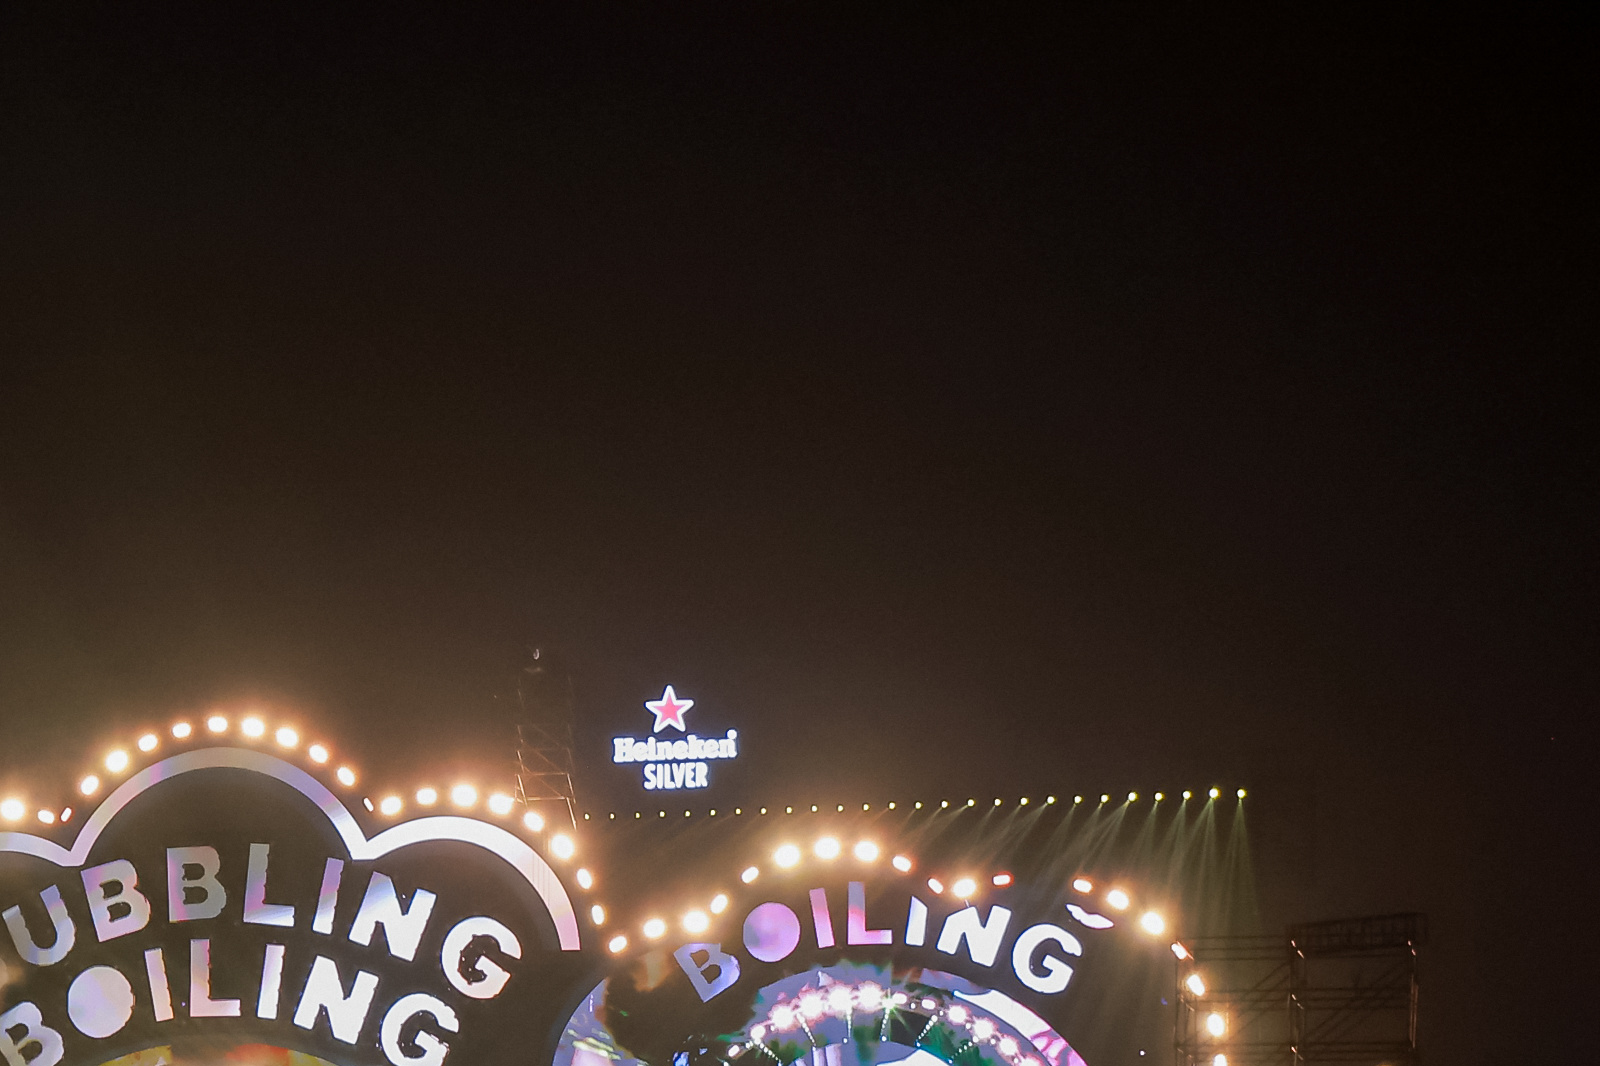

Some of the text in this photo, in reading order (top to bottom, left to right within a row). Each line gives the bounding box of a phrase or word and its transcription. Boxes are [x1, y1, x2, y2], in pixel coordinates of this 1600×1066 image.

[613, 729, 738, 763] Heineken
[643, 762, 708, 790] SILVER
[673, 881, 1083, 1003] BOILING
